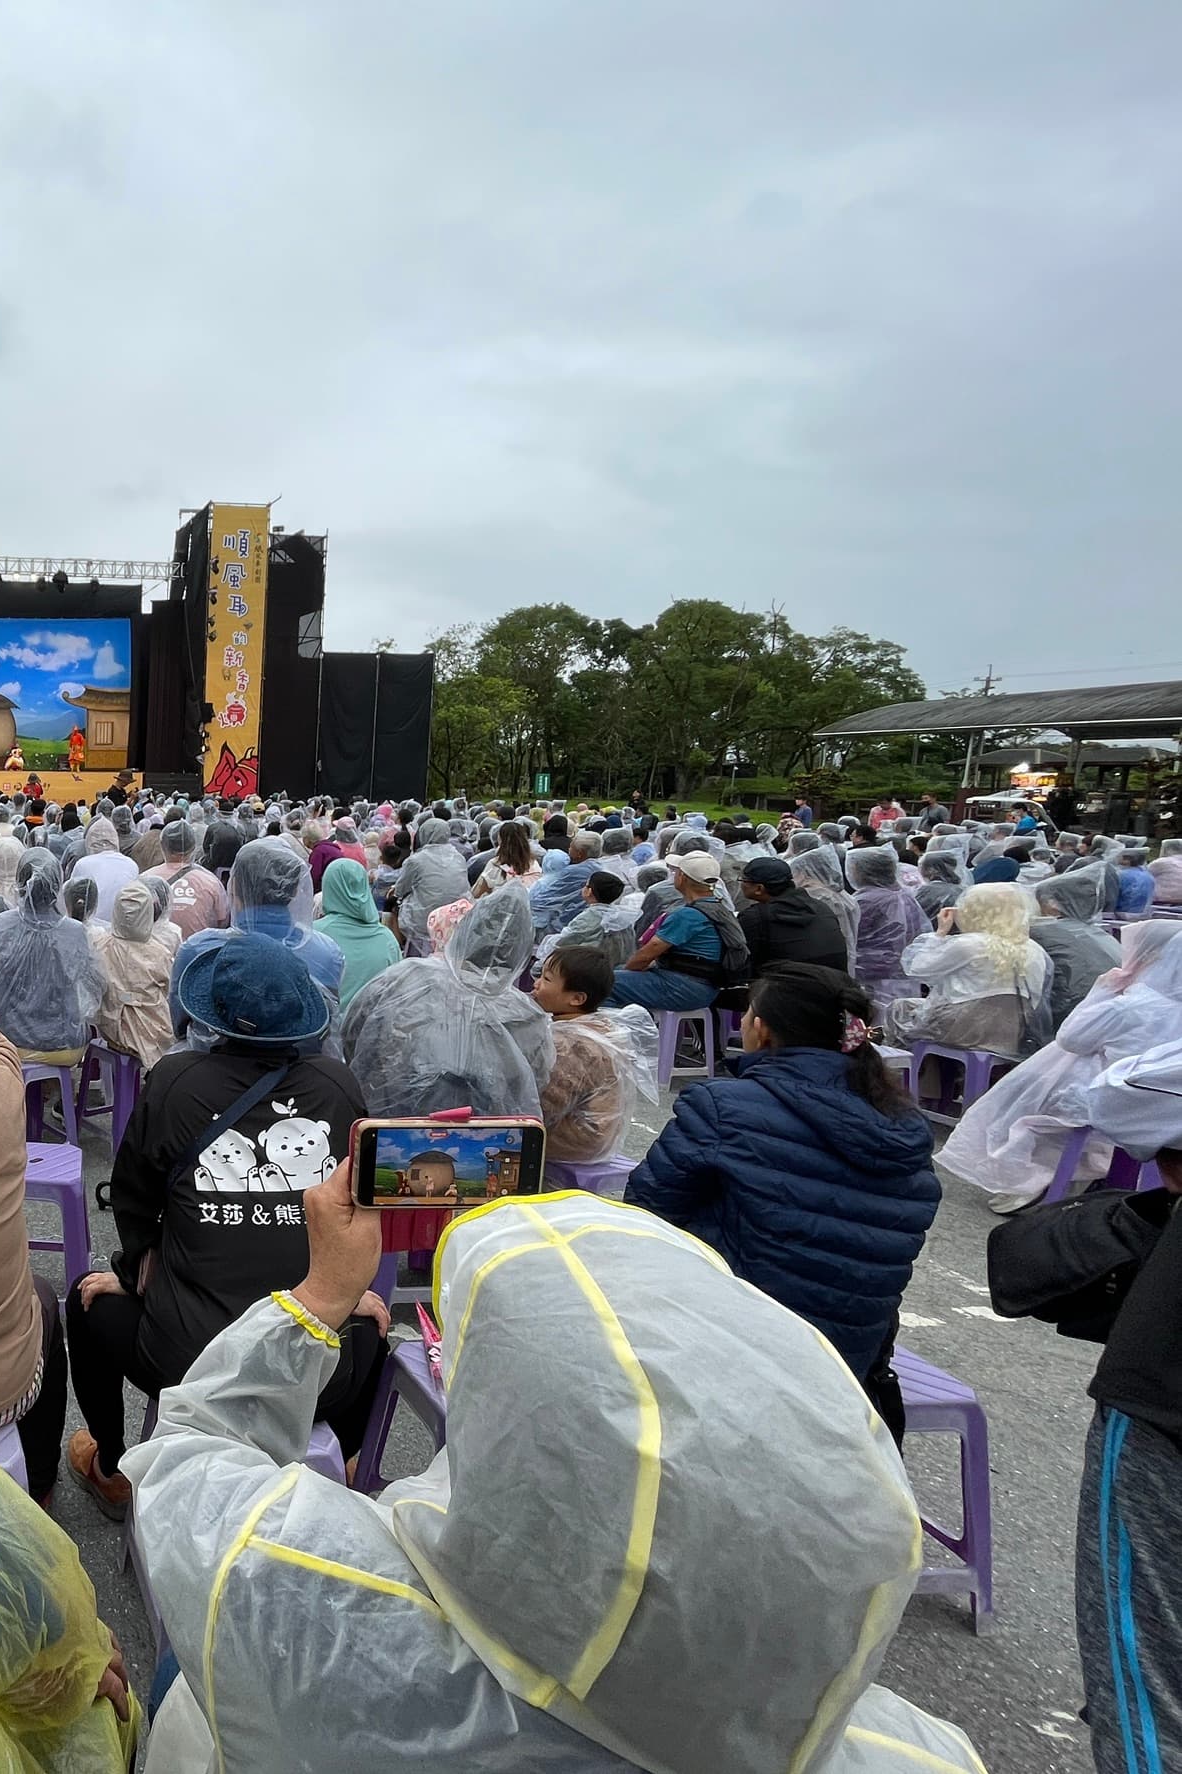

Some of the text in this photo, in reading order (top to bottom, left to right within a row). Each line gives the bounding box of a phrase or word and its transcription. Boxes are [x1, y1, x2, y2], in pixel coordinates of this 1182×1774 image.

[199, 1202, 307, 1225] 艾莎 & 熊
